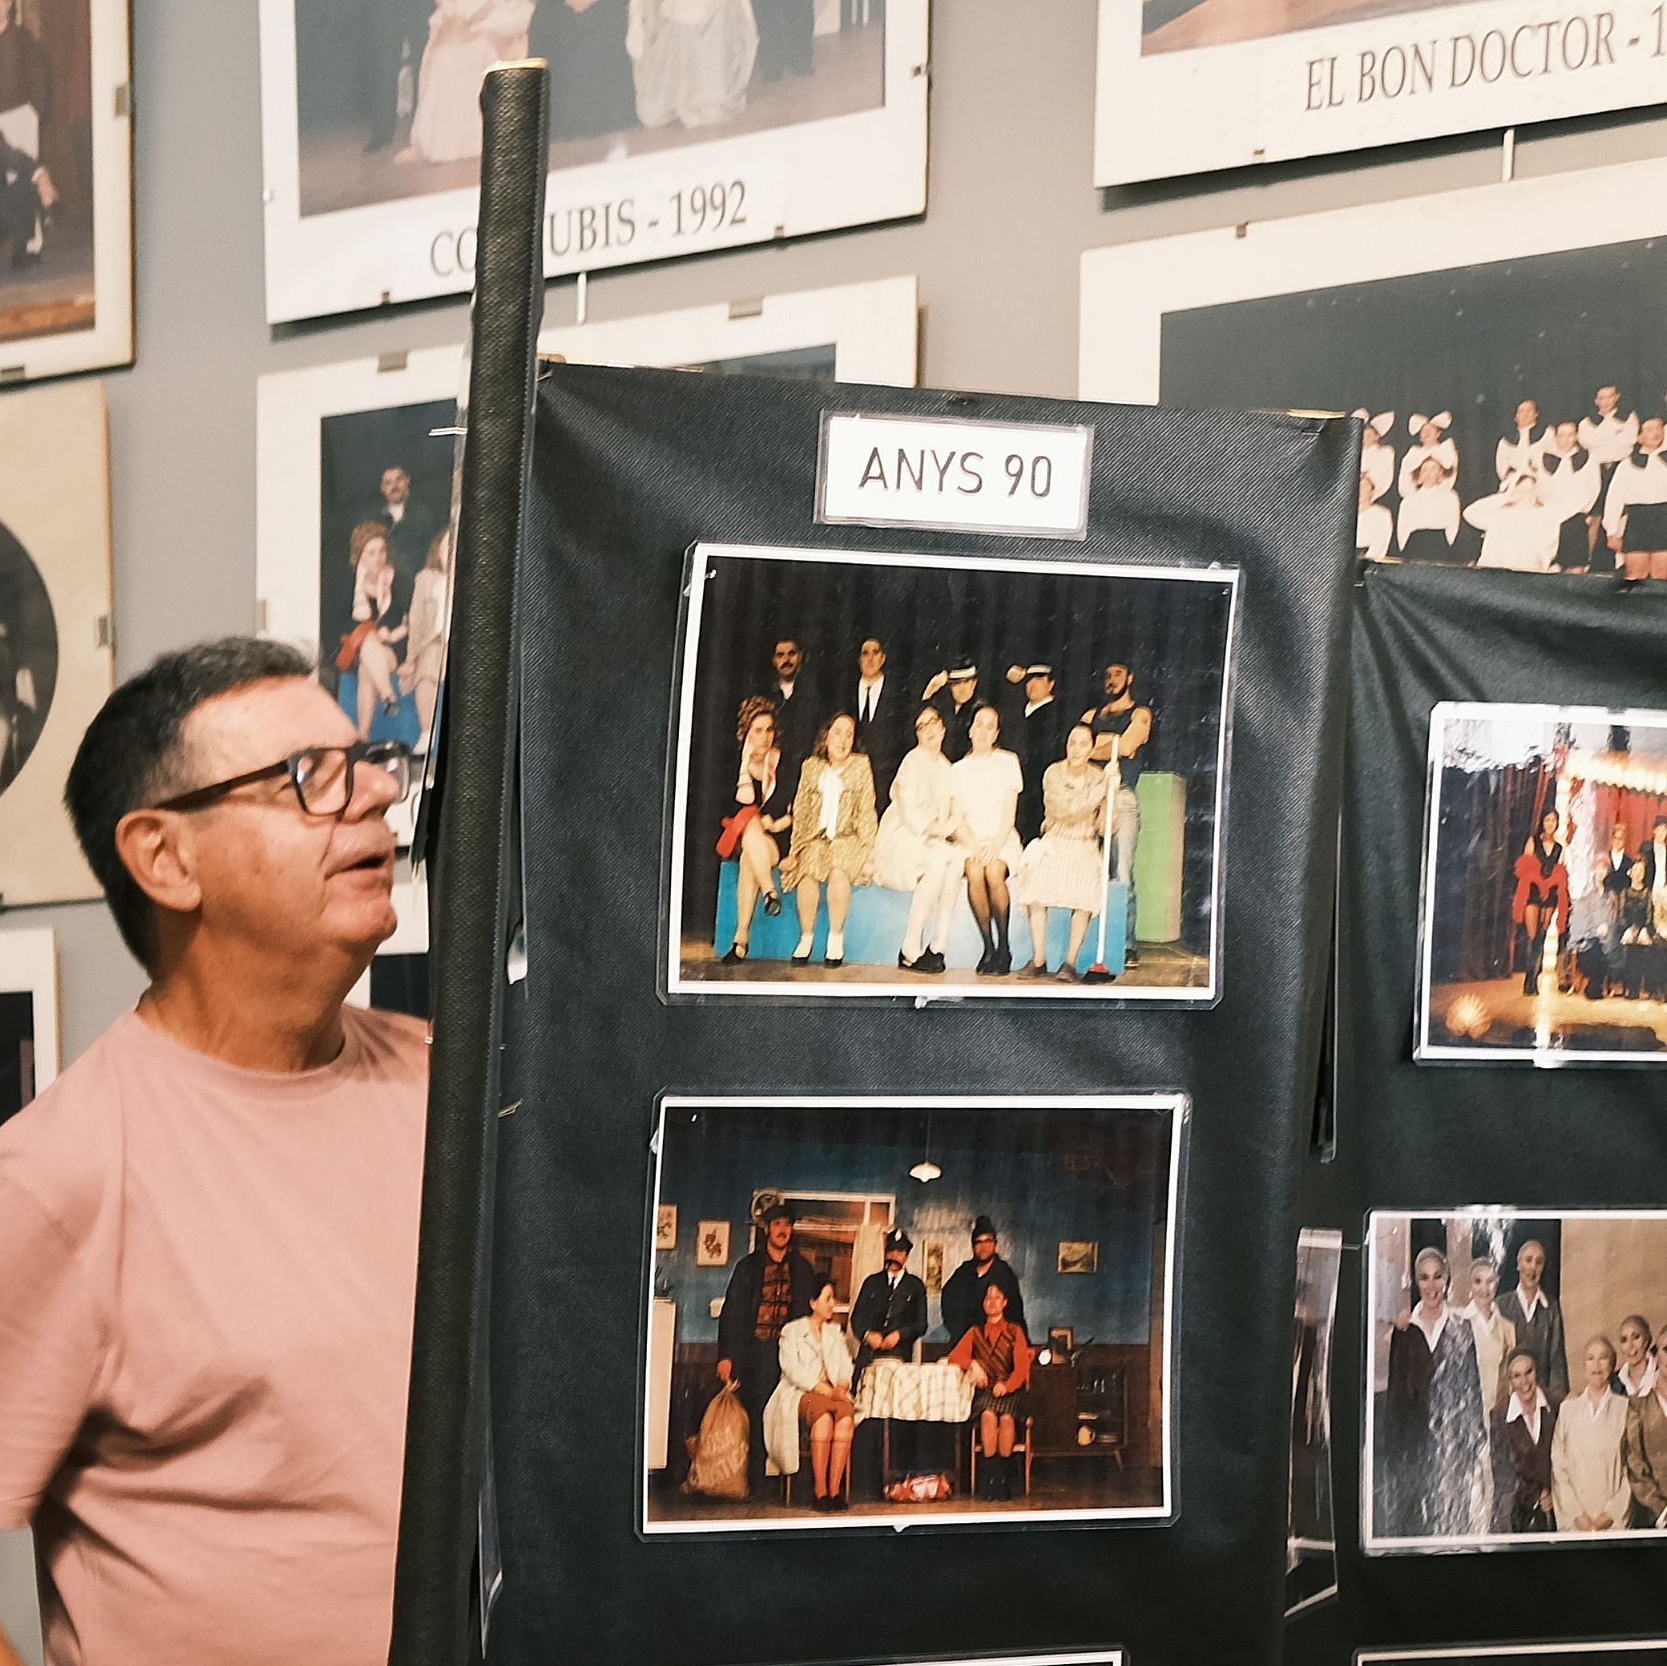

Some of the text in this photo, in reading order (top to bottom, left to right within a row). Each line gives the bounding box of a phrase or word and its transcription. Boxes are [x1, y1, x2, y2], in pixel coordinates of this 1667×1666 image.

[1305, 55, 1344, 112] EL
[1358, 40, 1437, 102] BON
[1449, 12, 1616, 88] DOCTOR
[430, 198, 636, 277] COUBIS
[670, 180, 747, 237] 1992
[857, 446, 1053, 498] ANYS 90
